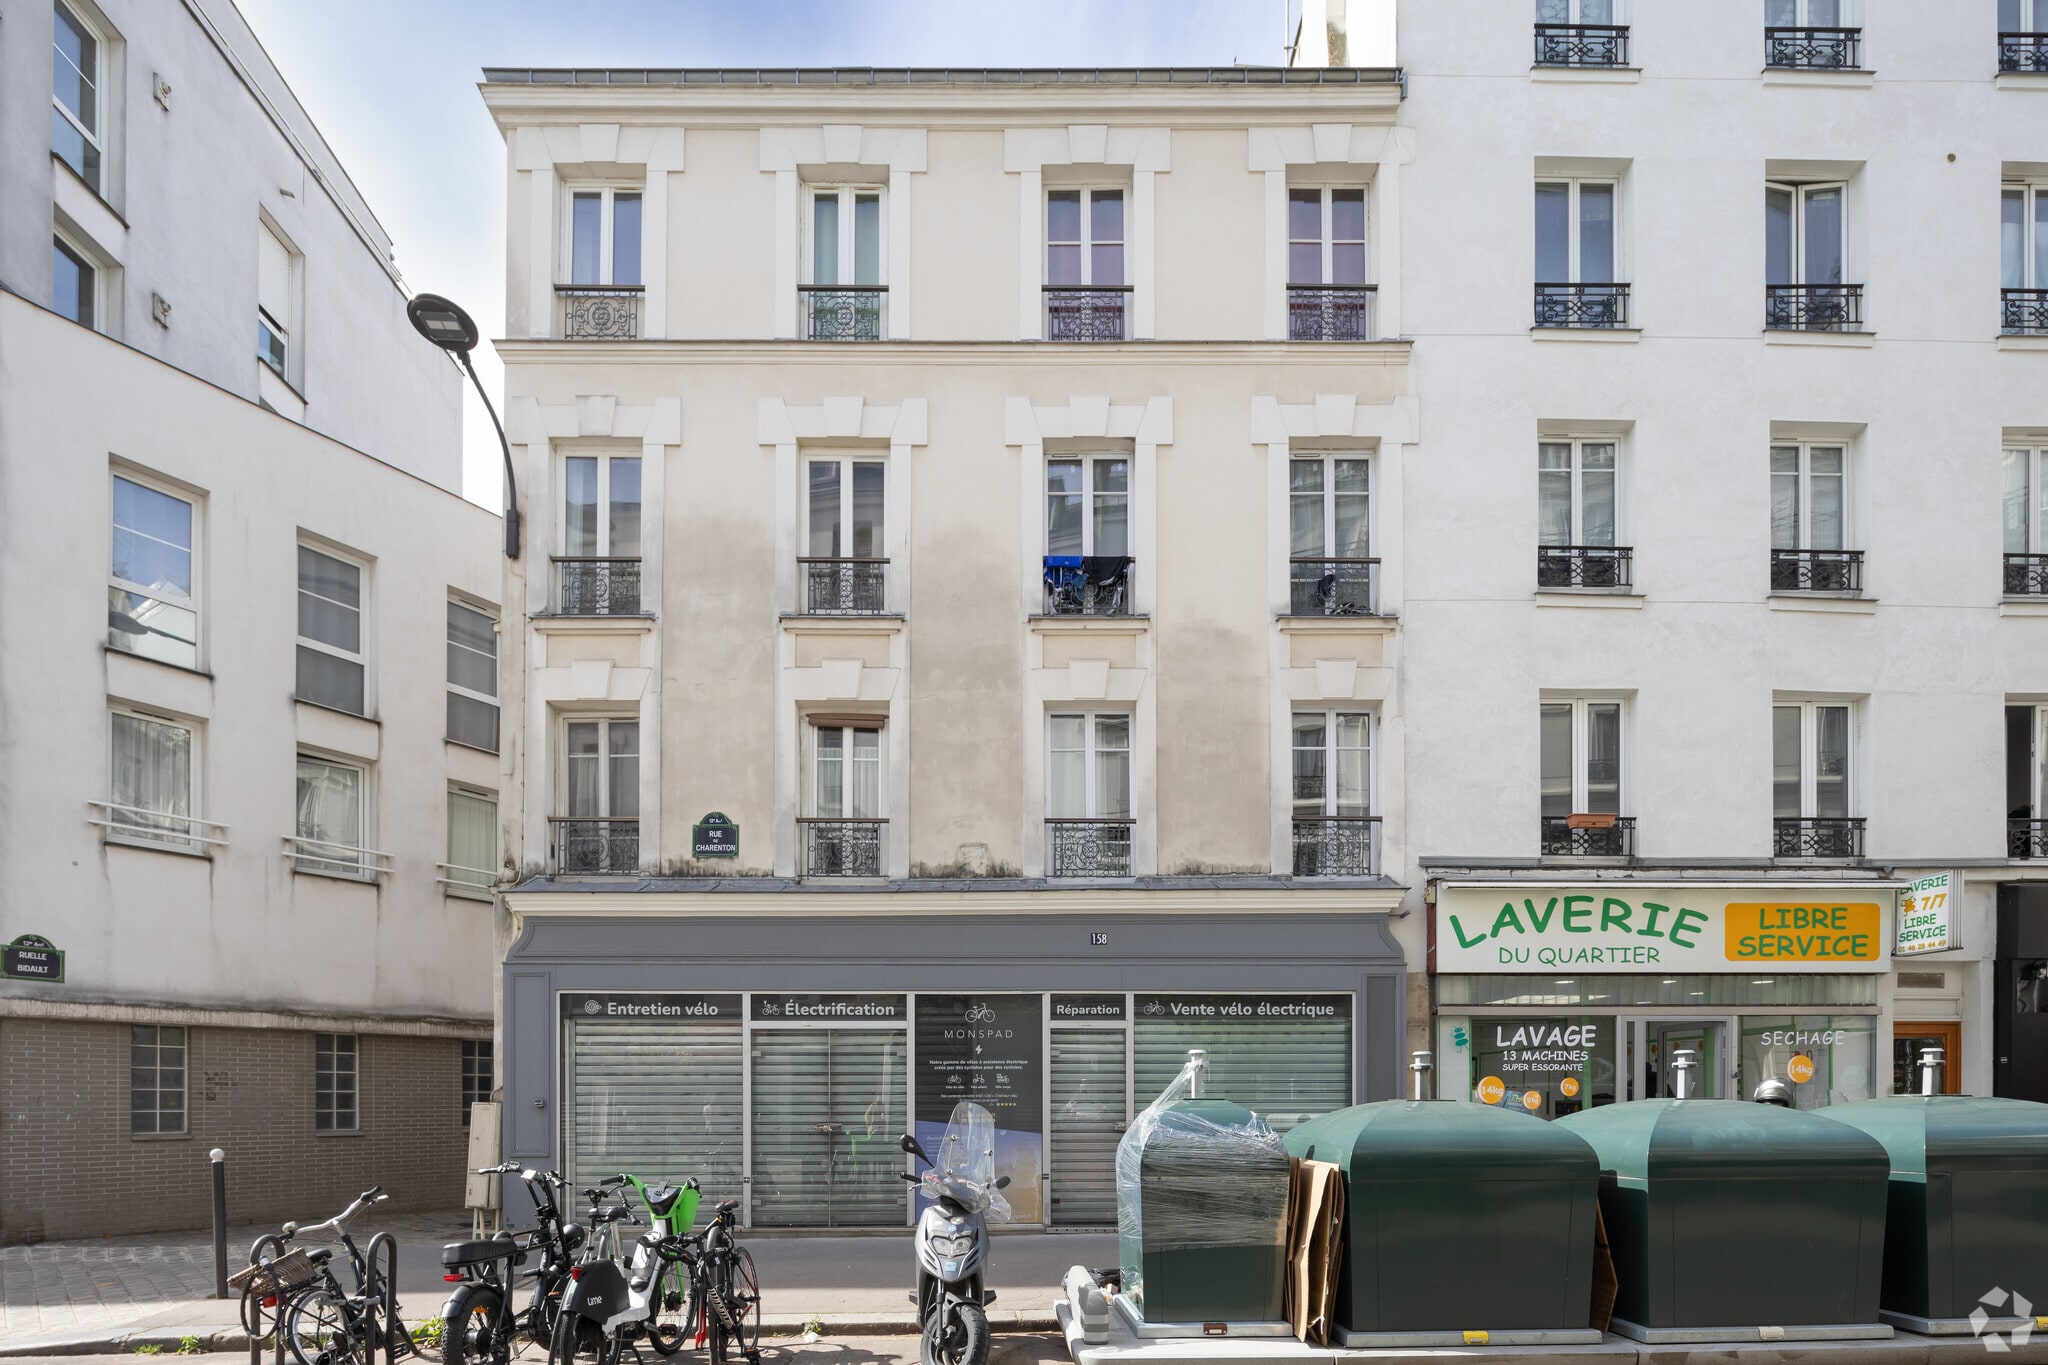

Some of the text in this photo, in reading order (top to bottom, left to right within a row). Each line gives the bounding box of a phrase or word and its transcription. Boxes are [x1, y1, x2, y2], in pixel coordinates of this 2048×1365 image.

[708, 830, 723, 838] RUE
[695, 844, 736, 852] CHARENTON
[1921, 893, 1948, 911] 7/7
[1449, 895, 1710, 949] LAVERIE
[1759, 907, 1849, 930] LIBRE
[1904, 913, 1937, 930] LIBRE
[1091, 933, 1108, 945] 158
[1898, 925, 1947, 943] SERVICE
[1736, 934, 1869, 957] SERVICE
[18, 951, 48, 961] RUELLE
[1499, 946, 1661, 967] DU QUARTIER
[17, 964, 49, 974] BIDAULT
[607, 1001, 719, 1016] Entretien vélo
[785, 999, 895, 1016] Électrification
[1056, 1004, 1120, 1017] Réparation
[1170, 1002, 1335, 1018] Vente vélo électrique
[944, 1029, 1014, 1039] MONSPAD
[1496, 1025, 1597, 1047] LAVAGE
[1760, 1030, 1846, 1046] SECHAGE
[1502, 1050, 1589, 1061] 13 MACHINES
[1502, 1063, 1584, 1072] SUPER ESSORANTE
[1790, 1064, 1813, 1077] 14kg
[1481, 1084, 1504, 1097] 14kg
[1564, 1083, 1577, 1092] 7kg
[1526, 1096, 1539, 1105] 9kg
